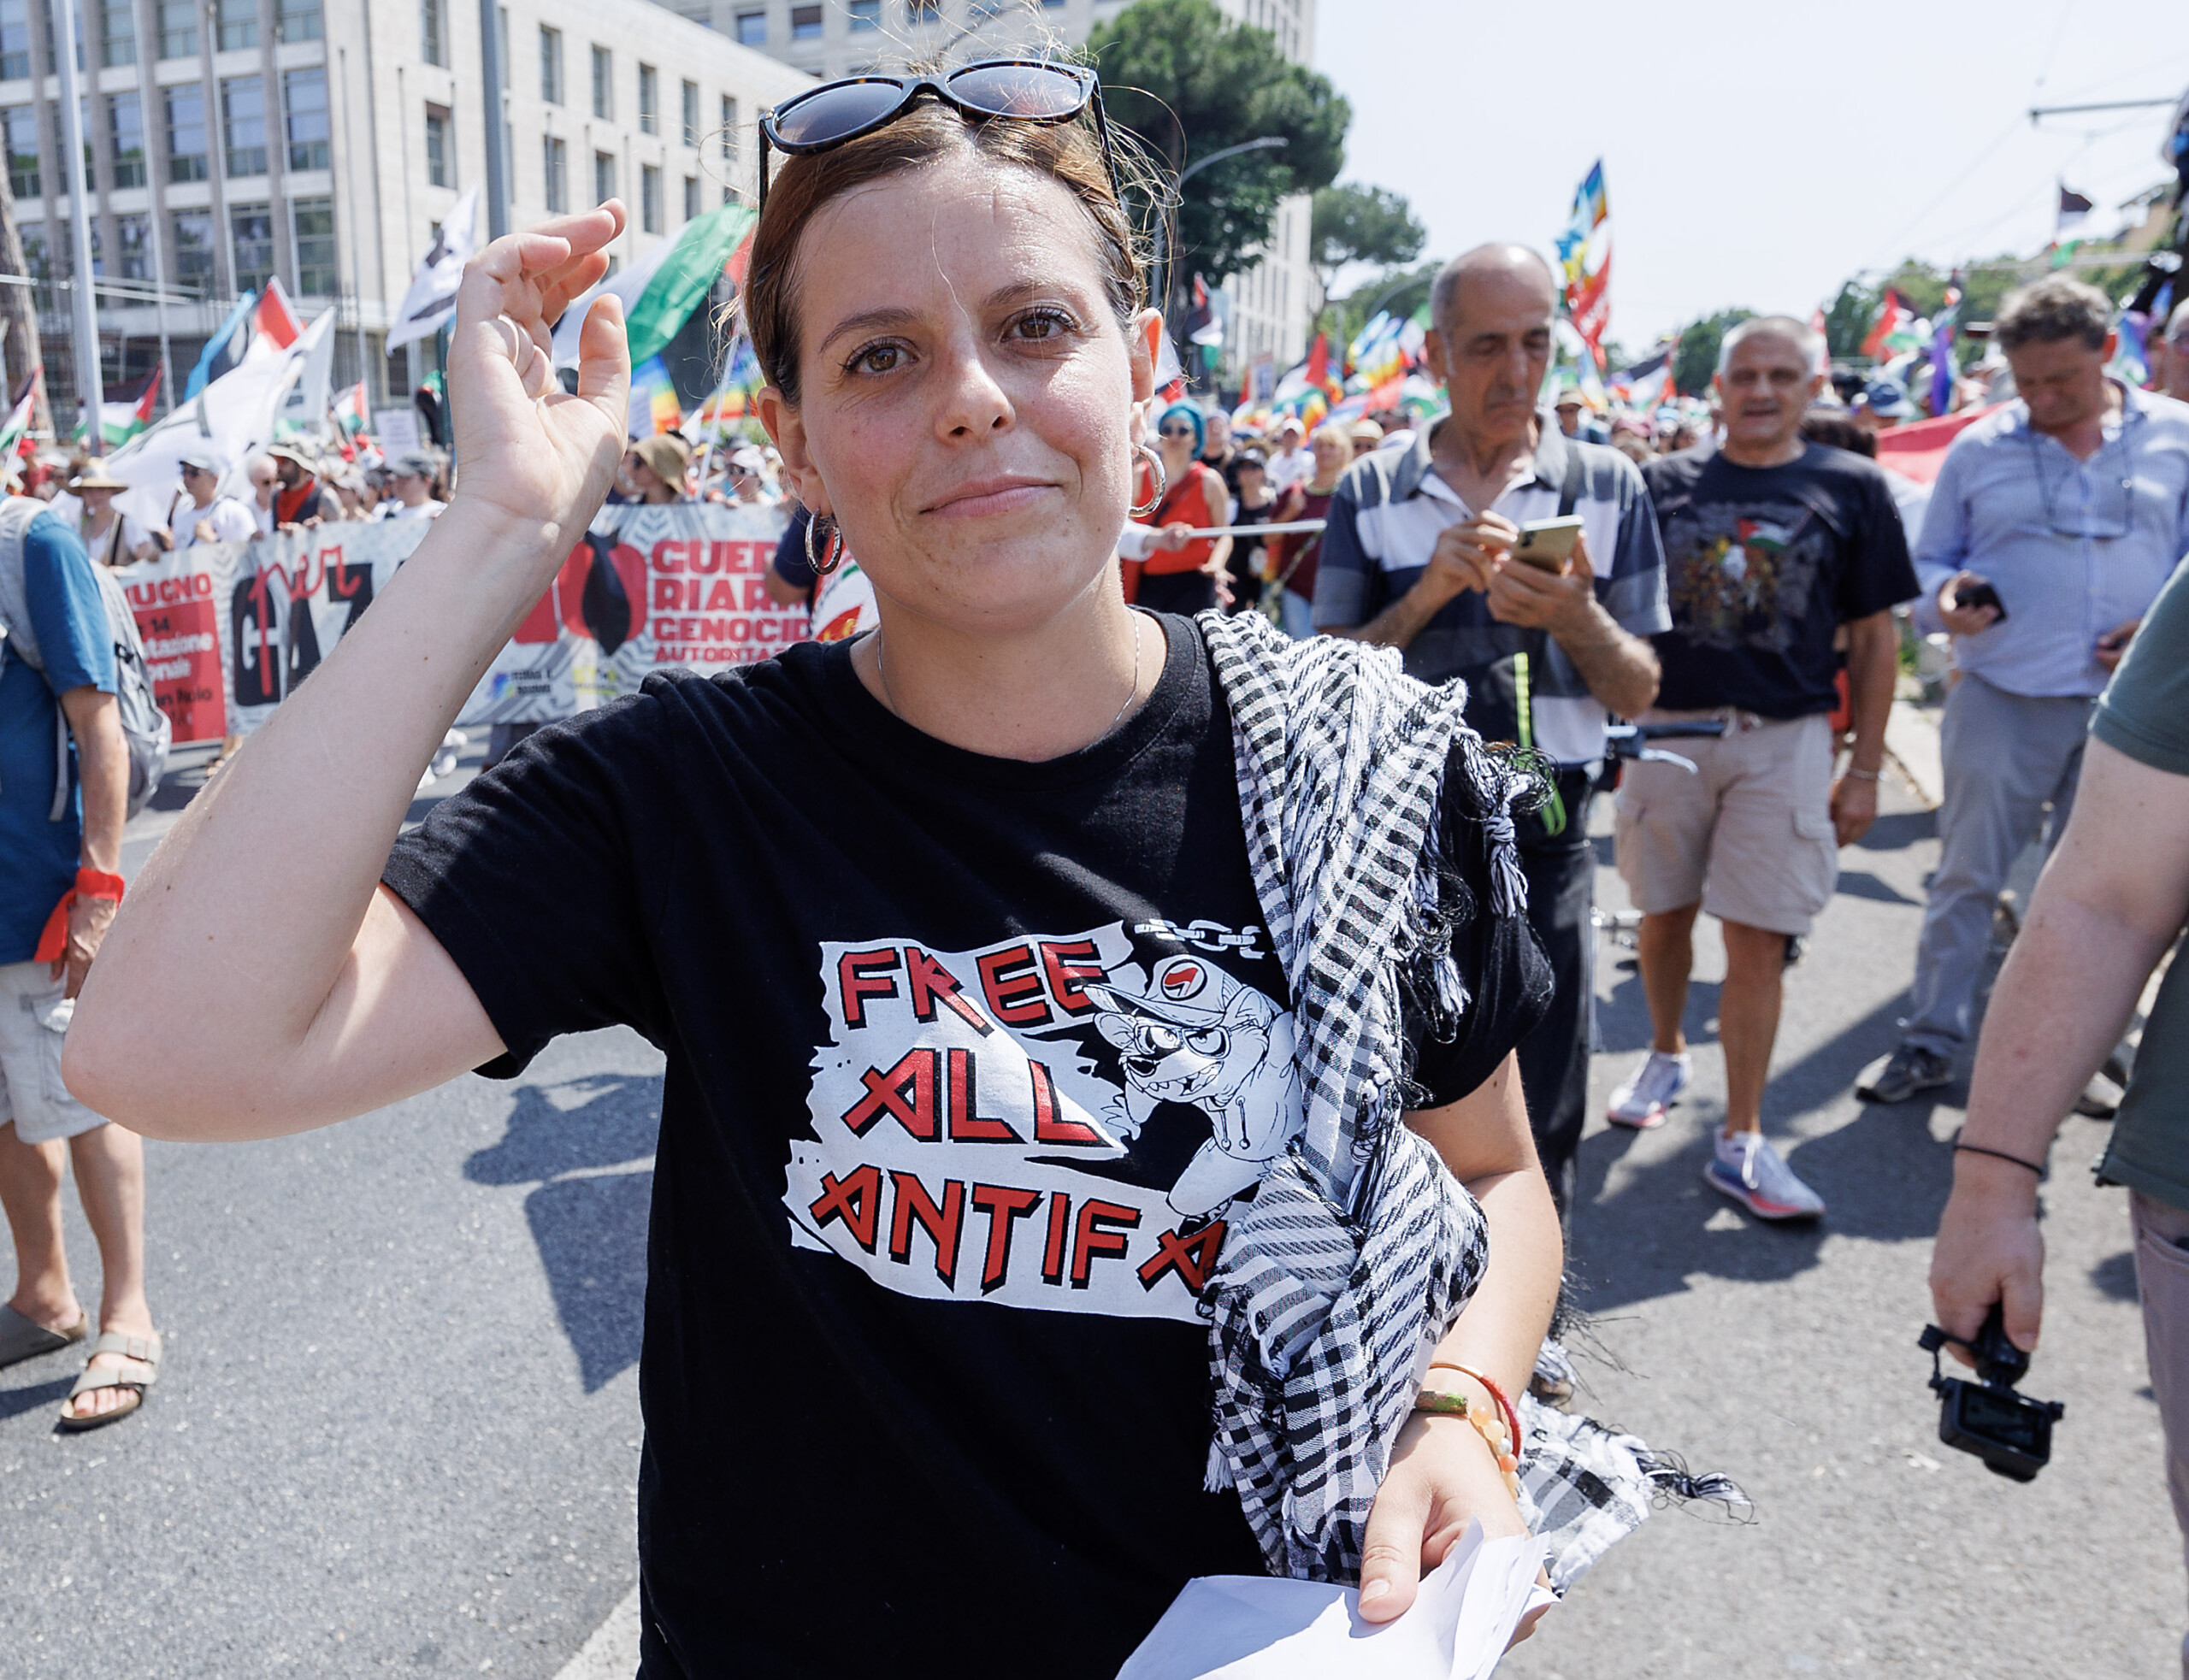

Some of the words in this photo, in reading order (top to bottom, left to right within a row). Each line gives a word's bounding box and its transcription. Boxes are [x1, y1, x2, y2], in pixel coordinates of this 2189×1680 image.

[232, 561, 405, 708] GAZ
[654, 645, 788, 663] AUTORITA
[837, 940, 1105, 1037] FREE
[842, 1046, 1114, 1144] ALL
